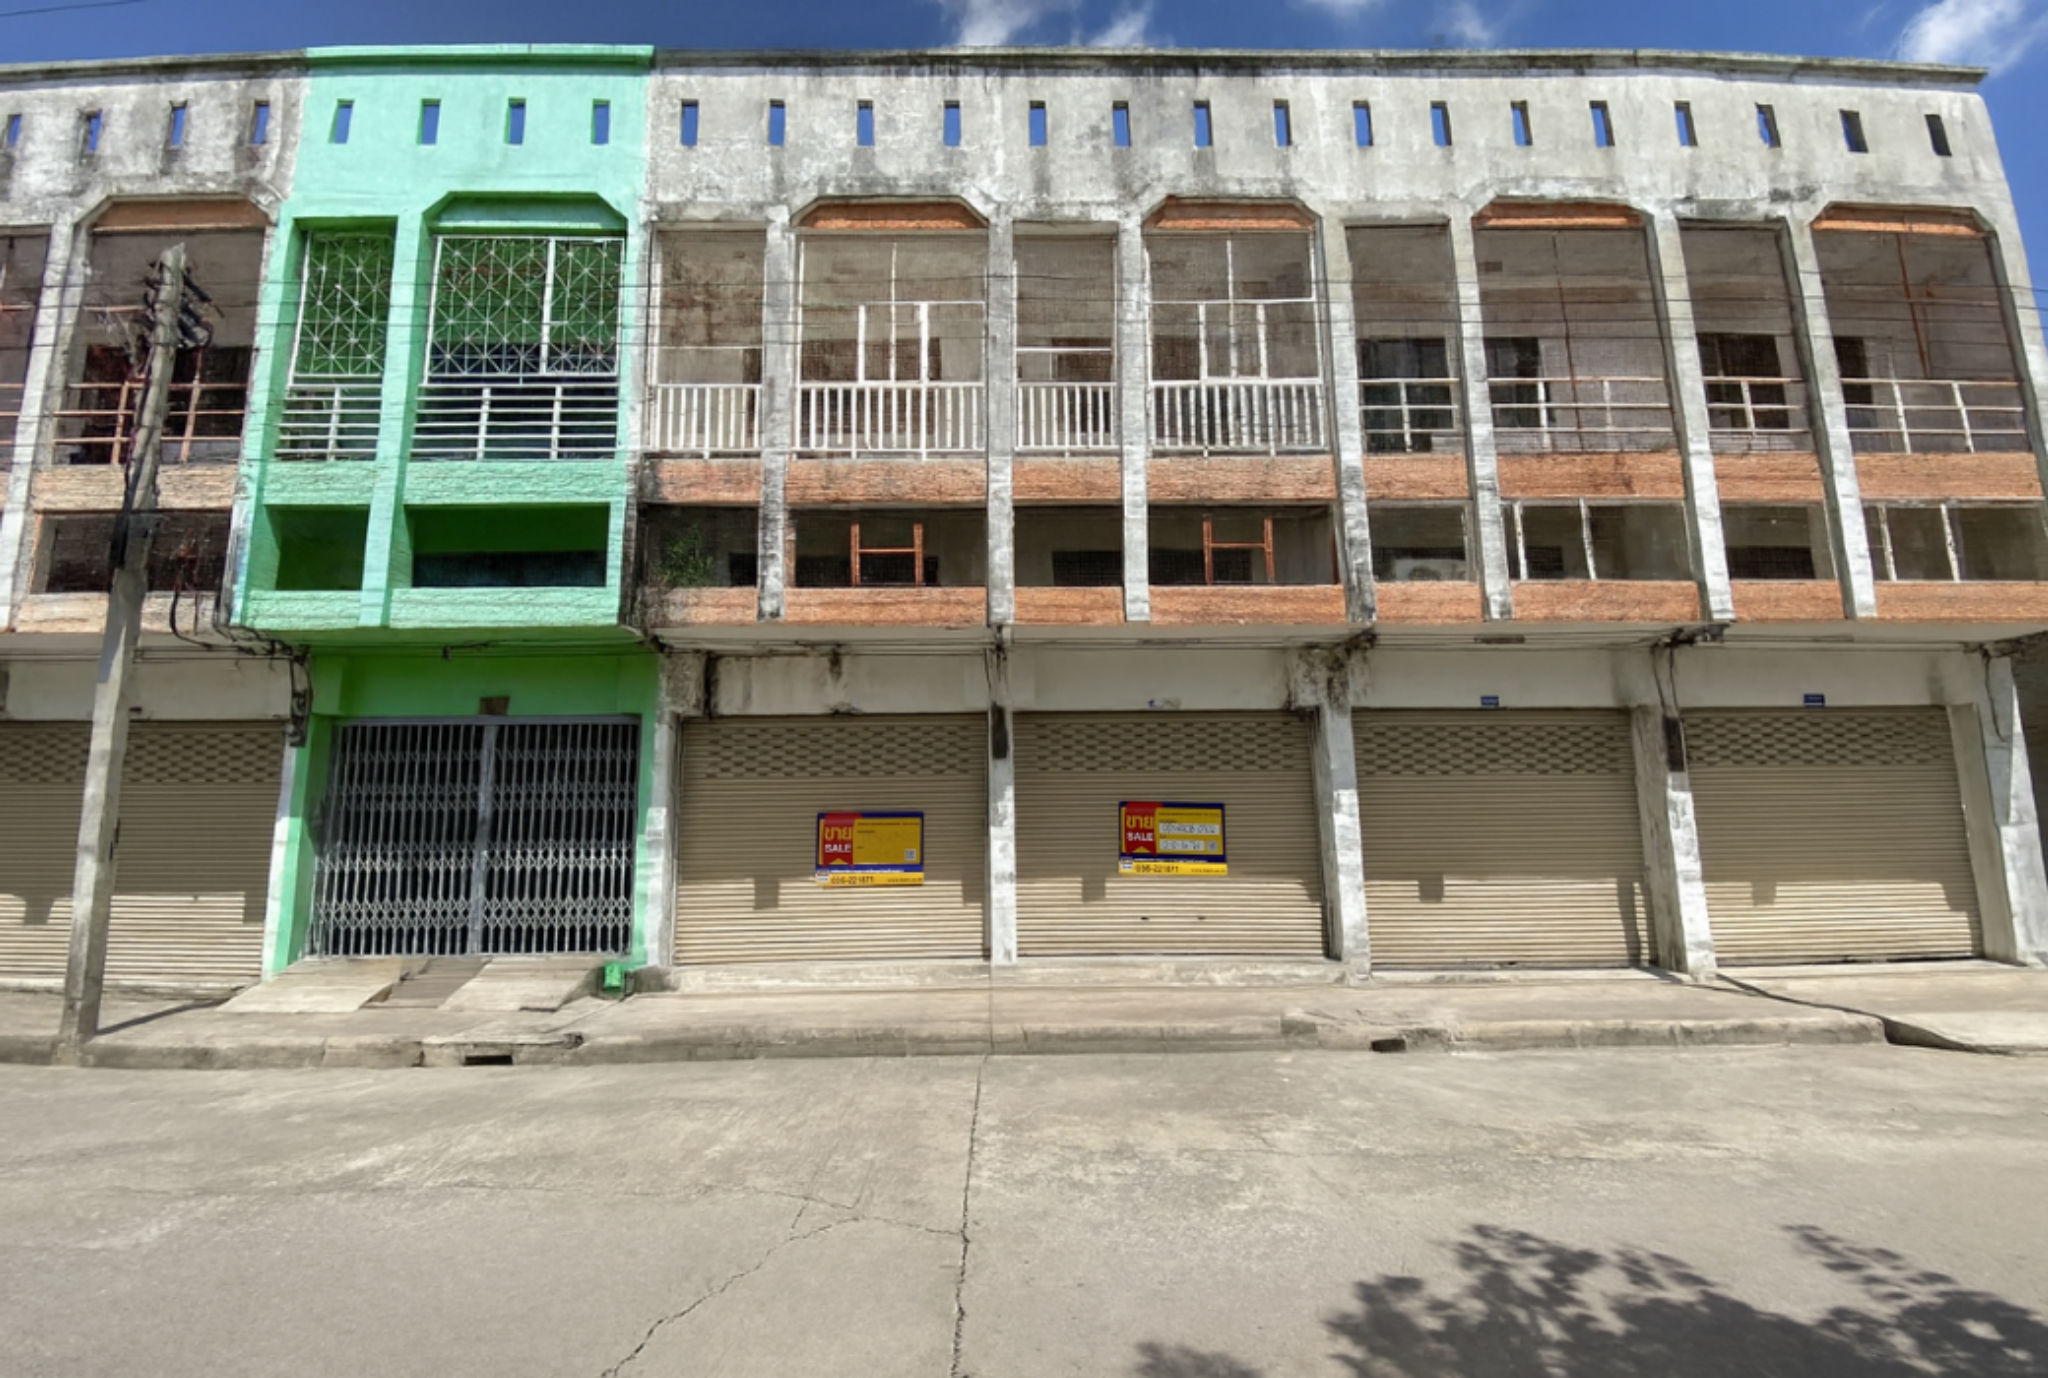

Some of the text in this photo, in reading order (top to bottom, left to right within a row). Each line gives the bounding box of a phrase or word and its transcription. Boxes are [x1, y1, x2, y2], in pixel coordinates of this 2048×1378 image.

[1126, 815, 1154, 830] ขาย
[825, 827, 852, 842] ขาย
[1126, 832, 1154, 842] SALE
[825, 843, 852, 853] SALE
